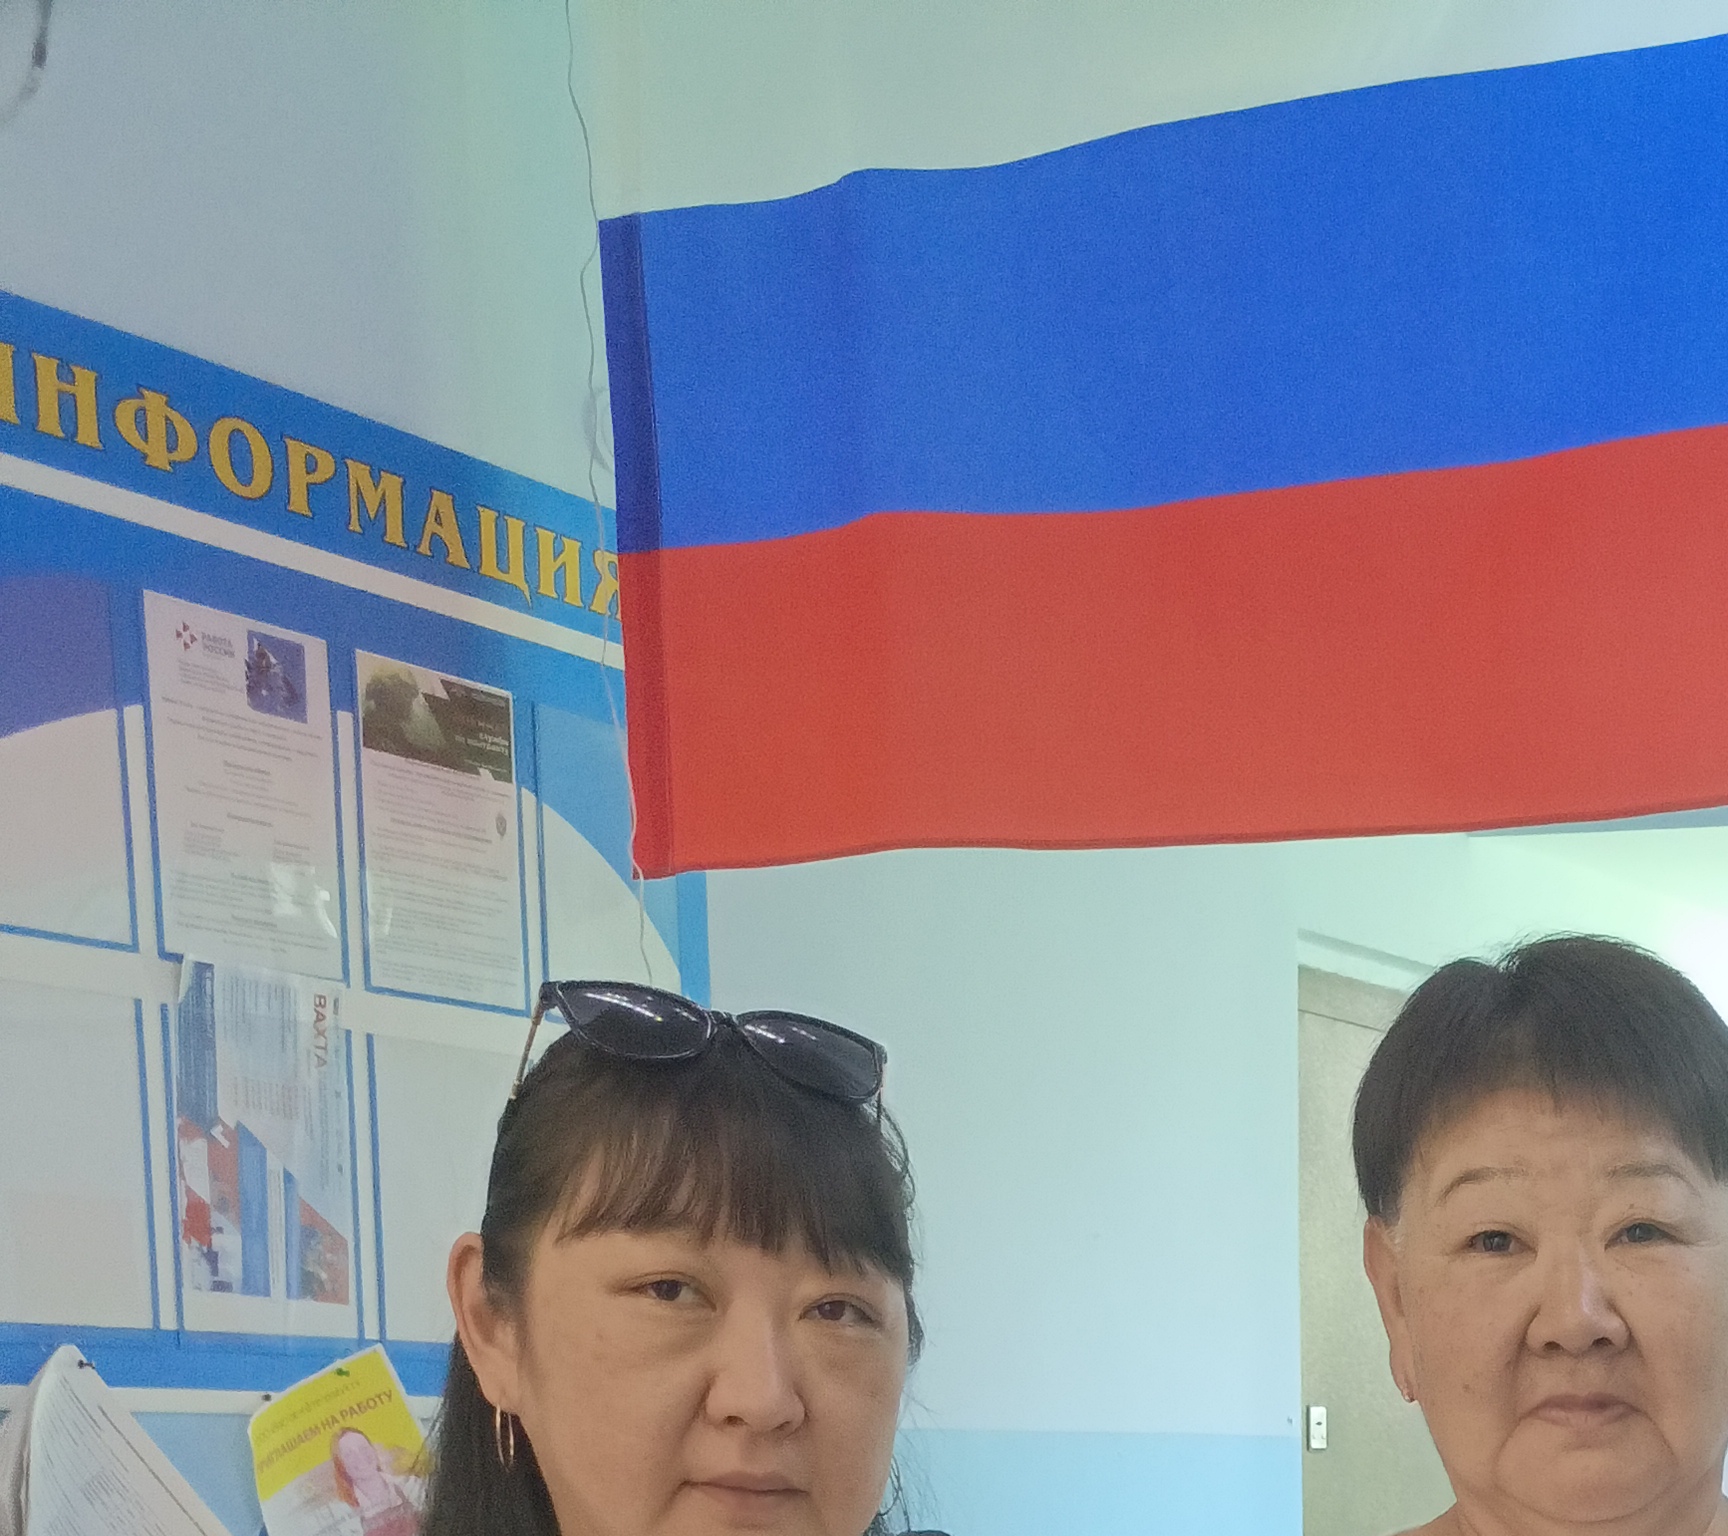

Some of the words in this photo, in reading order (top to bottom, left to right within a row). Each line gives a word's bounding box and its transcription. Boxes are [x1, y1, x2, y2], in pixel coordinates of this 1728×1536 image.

[0, 342, 622, 622] НФОРМАЦИЯ
[313, 994, 328, 1069] ВАХТА
[321, 1418, 340, 1432] НА
[340, 1389, 393, 1422] РАБОТУ
